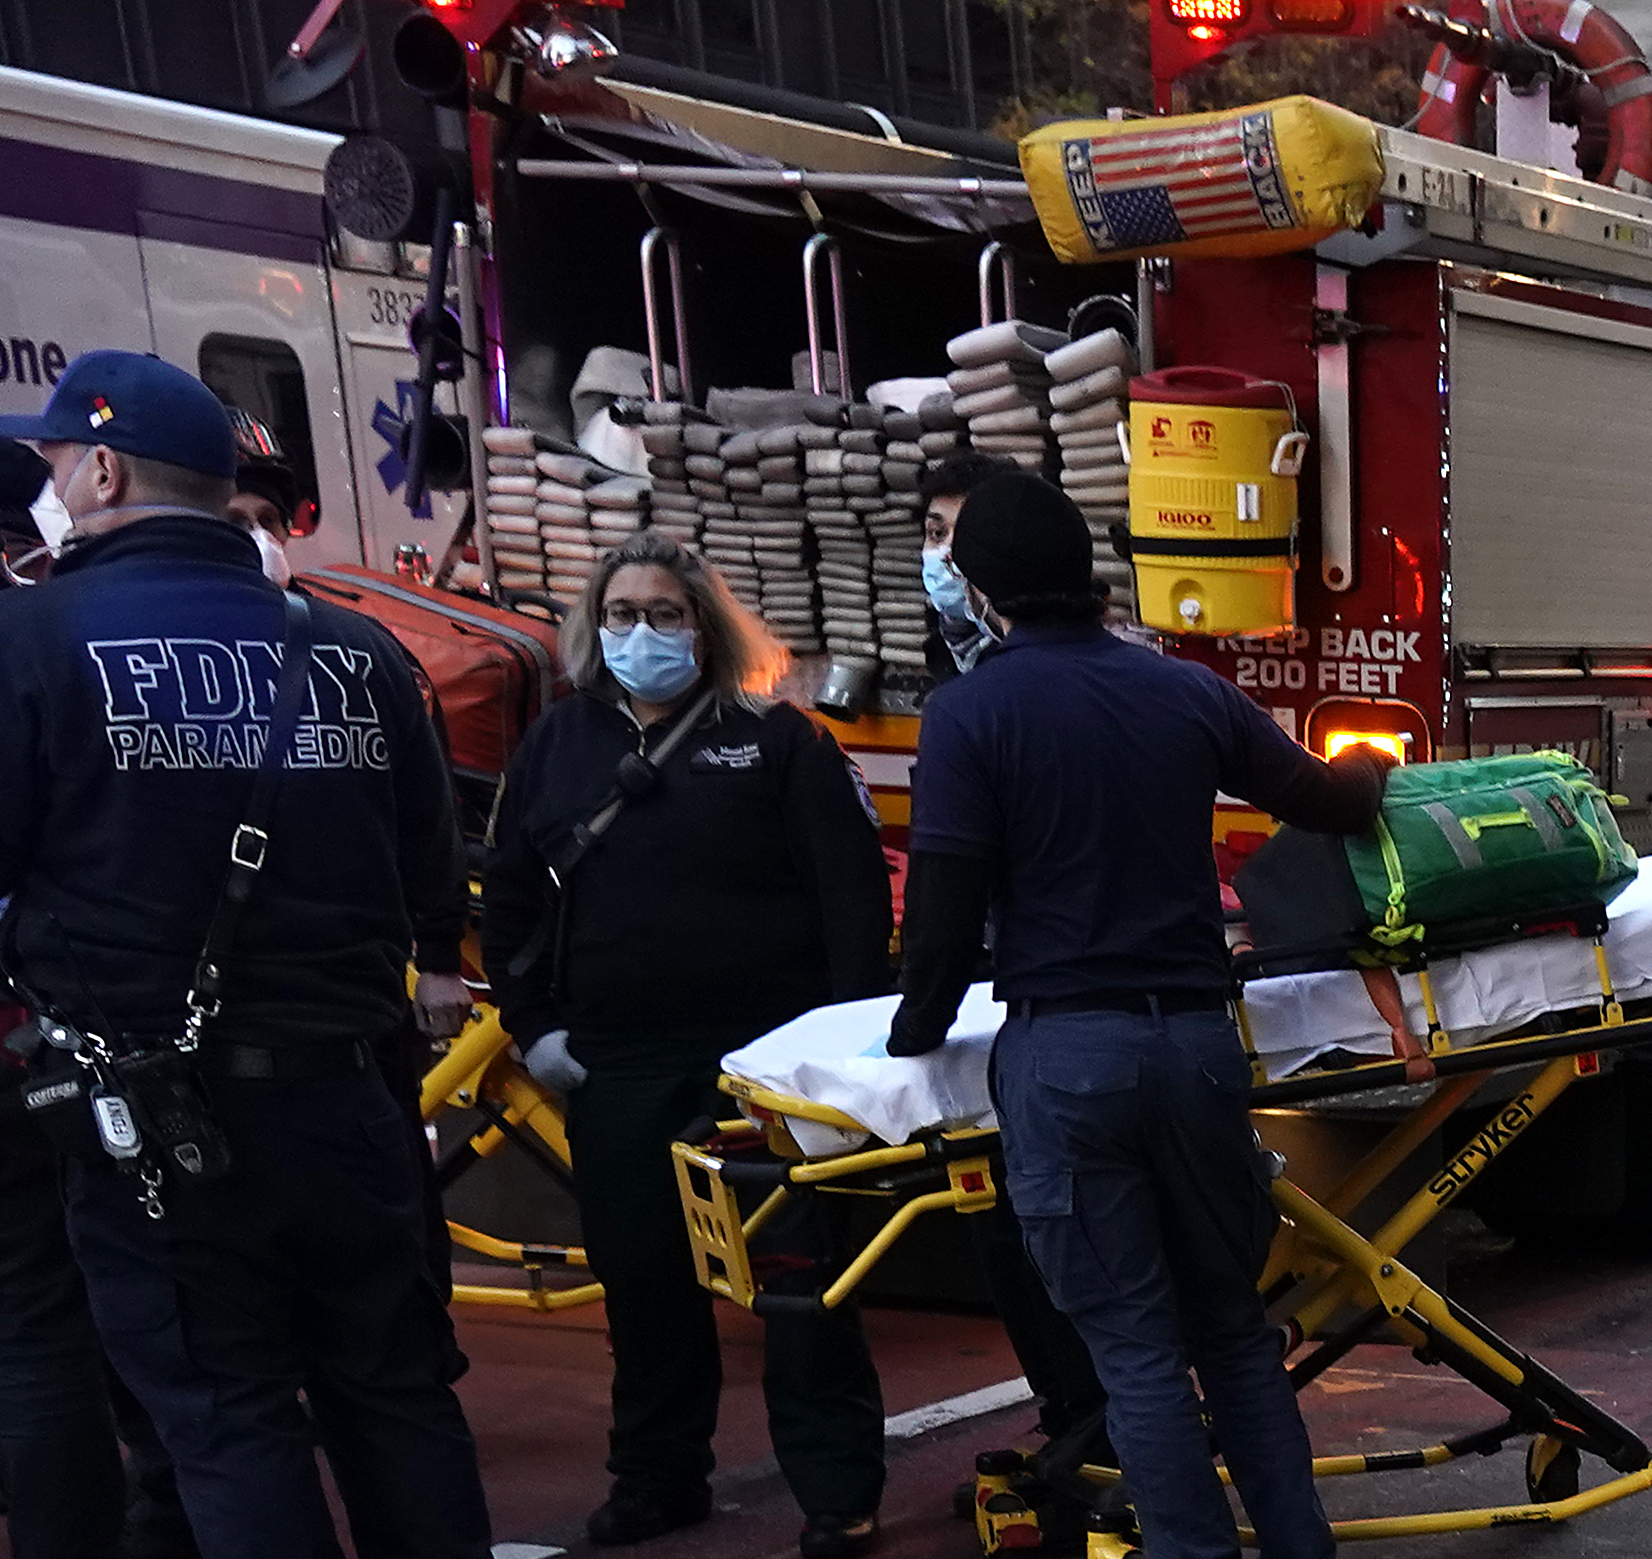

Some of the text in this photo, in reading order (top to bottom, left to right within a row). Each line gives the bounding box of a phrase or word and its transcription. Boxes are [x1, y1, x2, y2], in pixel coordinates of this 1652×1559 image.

[1065, 140, 1118, 251] KEEP
[1243, 112, 1294, 230] BACK
[87, 638, 379, 724] FDNY
[1236, 656, 1403, 694] 200 FEET
[1321, 627, 1422, 662] BACK
[1429, 1093, 1535, 1206] stryker
